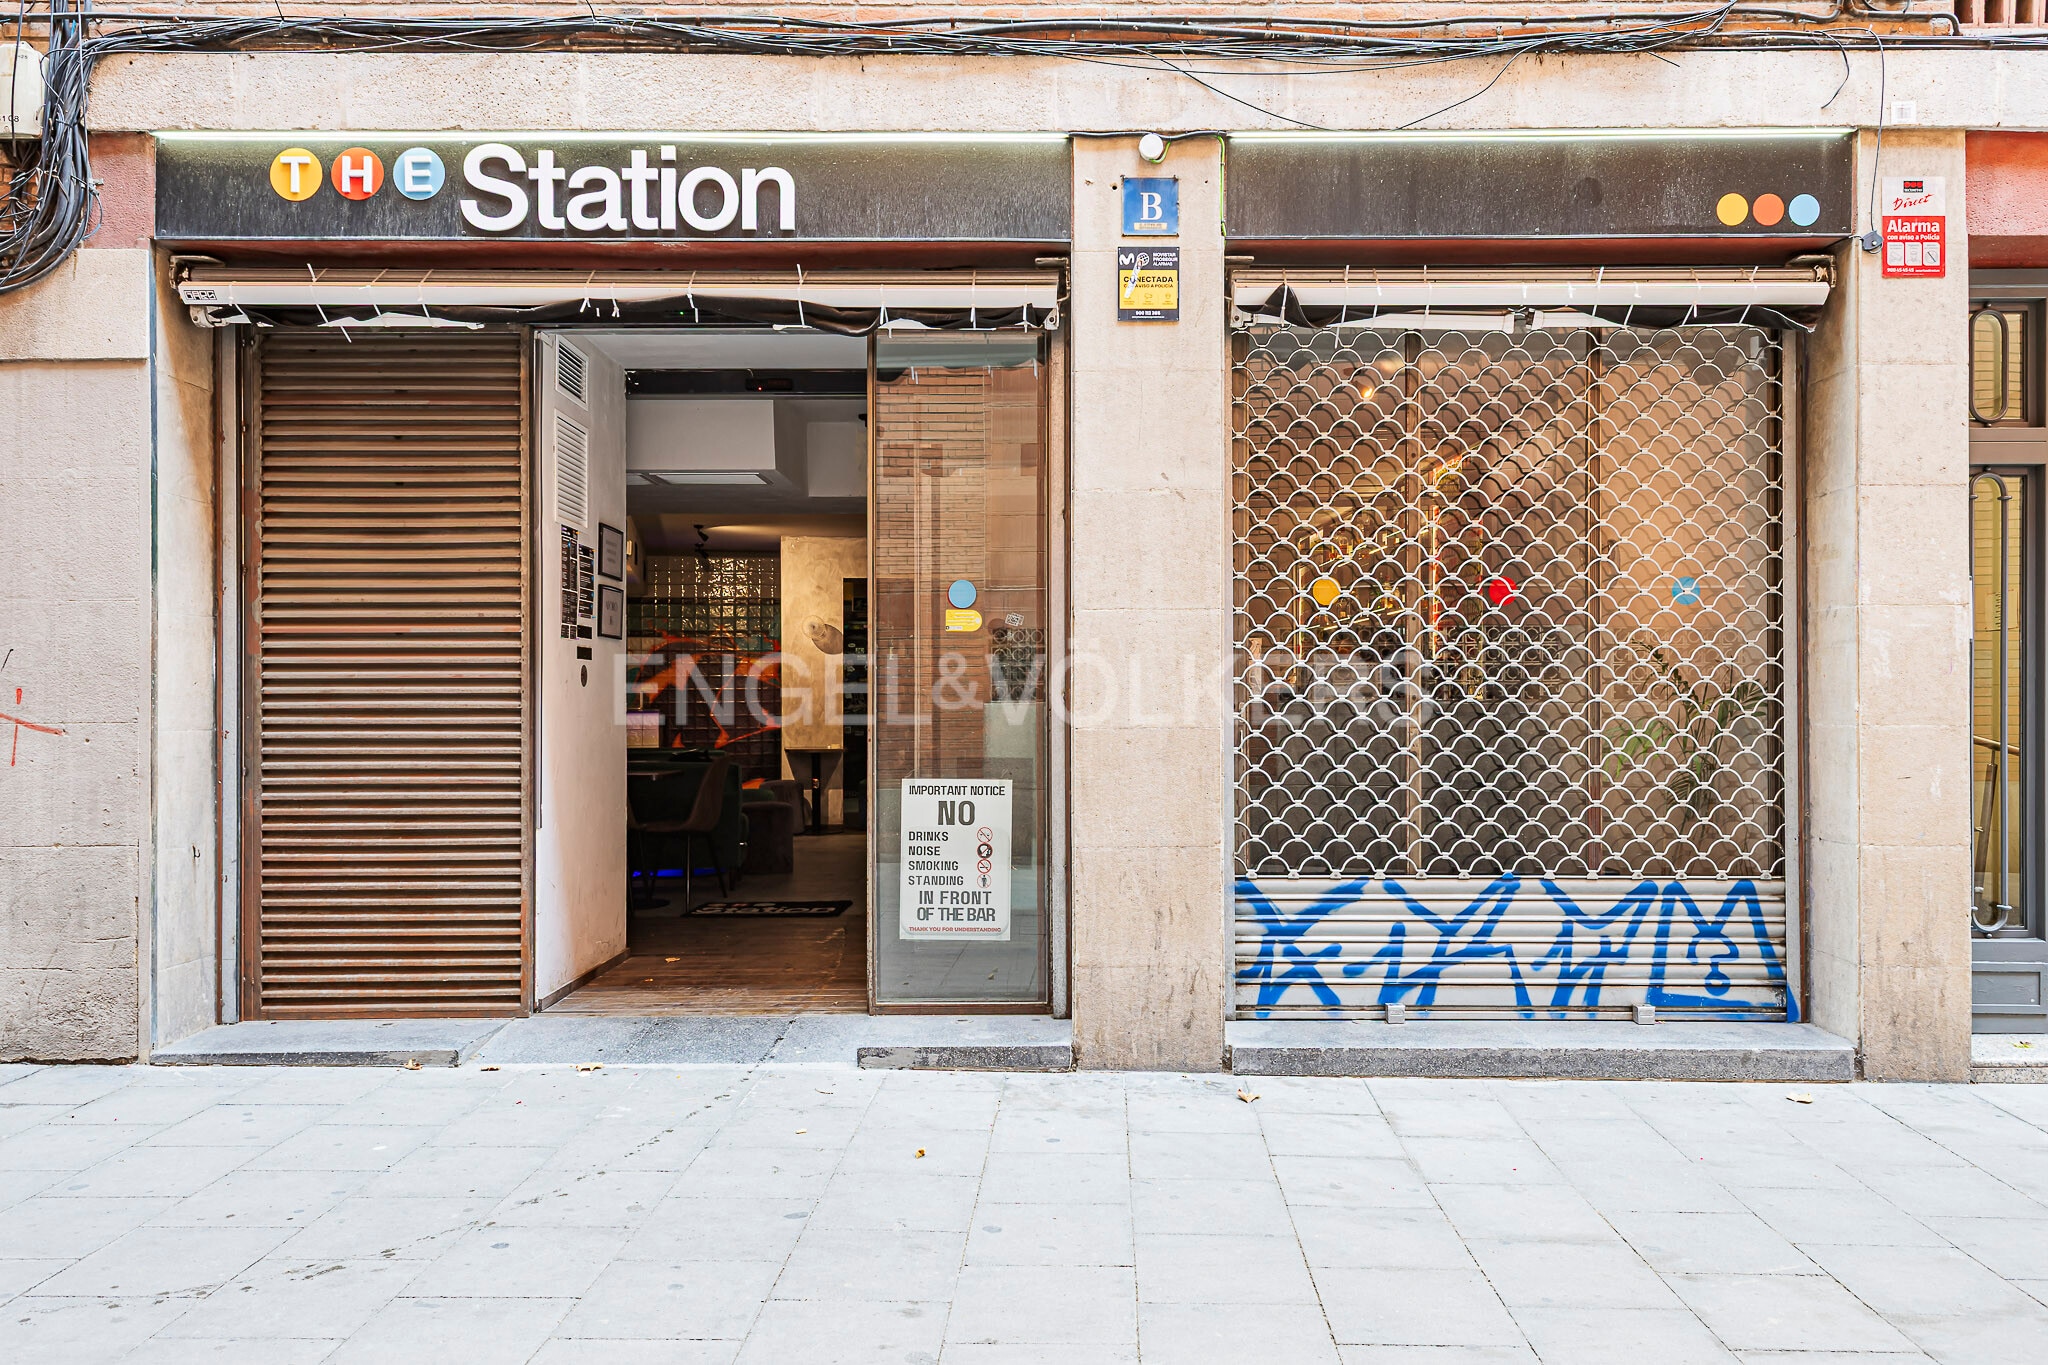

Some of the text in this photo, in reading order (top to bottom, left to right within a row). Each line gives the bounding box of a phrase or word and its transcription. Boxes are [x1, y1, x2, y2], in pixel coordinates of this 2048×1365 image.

[279, 143, 797, 232] THE Station
[1140, 192, 1163, 221] B
[1887, 218, 1940, 233] Alarma
[909, 785, 1006, 796] IMPORTANT NOTICE
[937, 800, 976, 826] NO
[908, 831, 949, 842] DRINKS
[908, 846, 941, 856] NOISE
[908, 860, 959, 871] SMOKING
[908, 875, 964, 886] STANDING
[919, 890, 992, 905] IN FRONT
[917, 907, 996, 922] OF THE BAR
